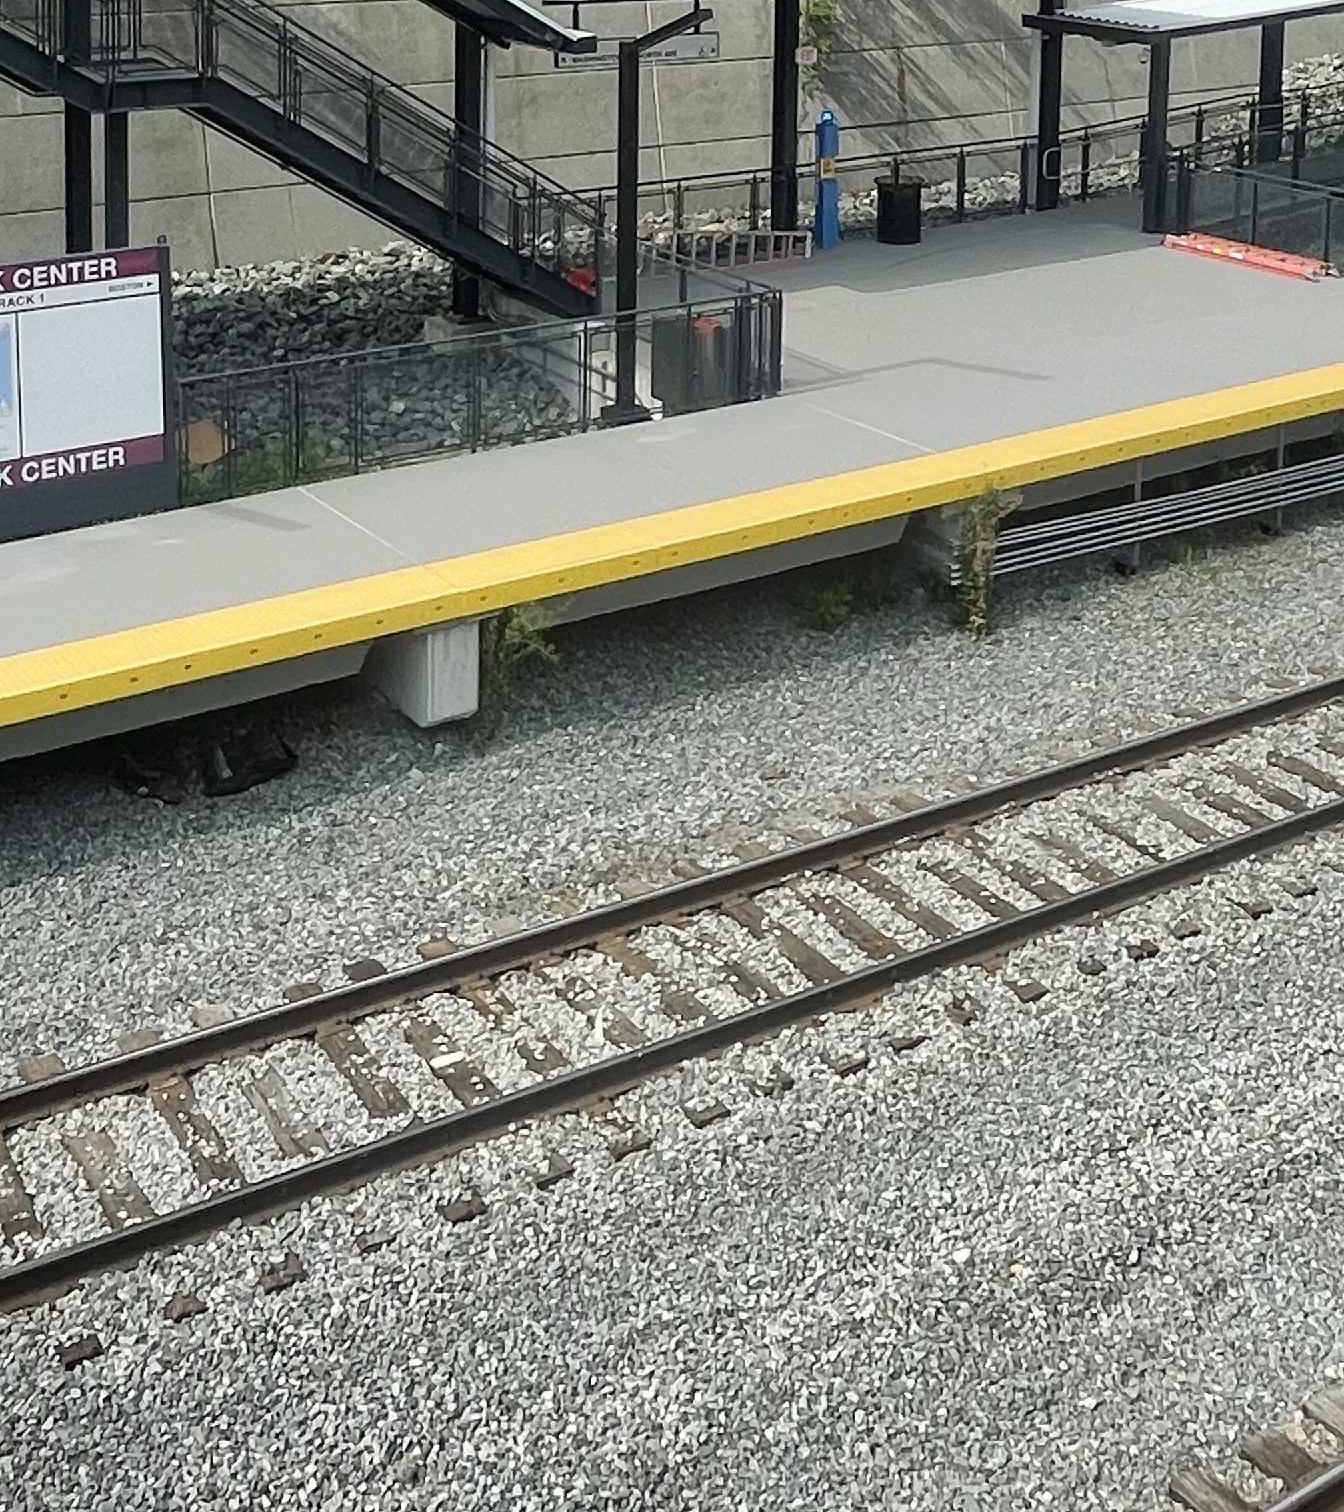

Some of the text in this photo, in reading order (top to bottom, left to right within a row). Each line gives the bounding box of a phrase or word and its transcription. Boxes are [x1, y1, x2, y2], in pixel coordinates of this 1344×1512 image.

[12, 257, 118, 289] CENTER
[39, 293, 45, 303] 1
[20, 446, 126, 482] CENTER
